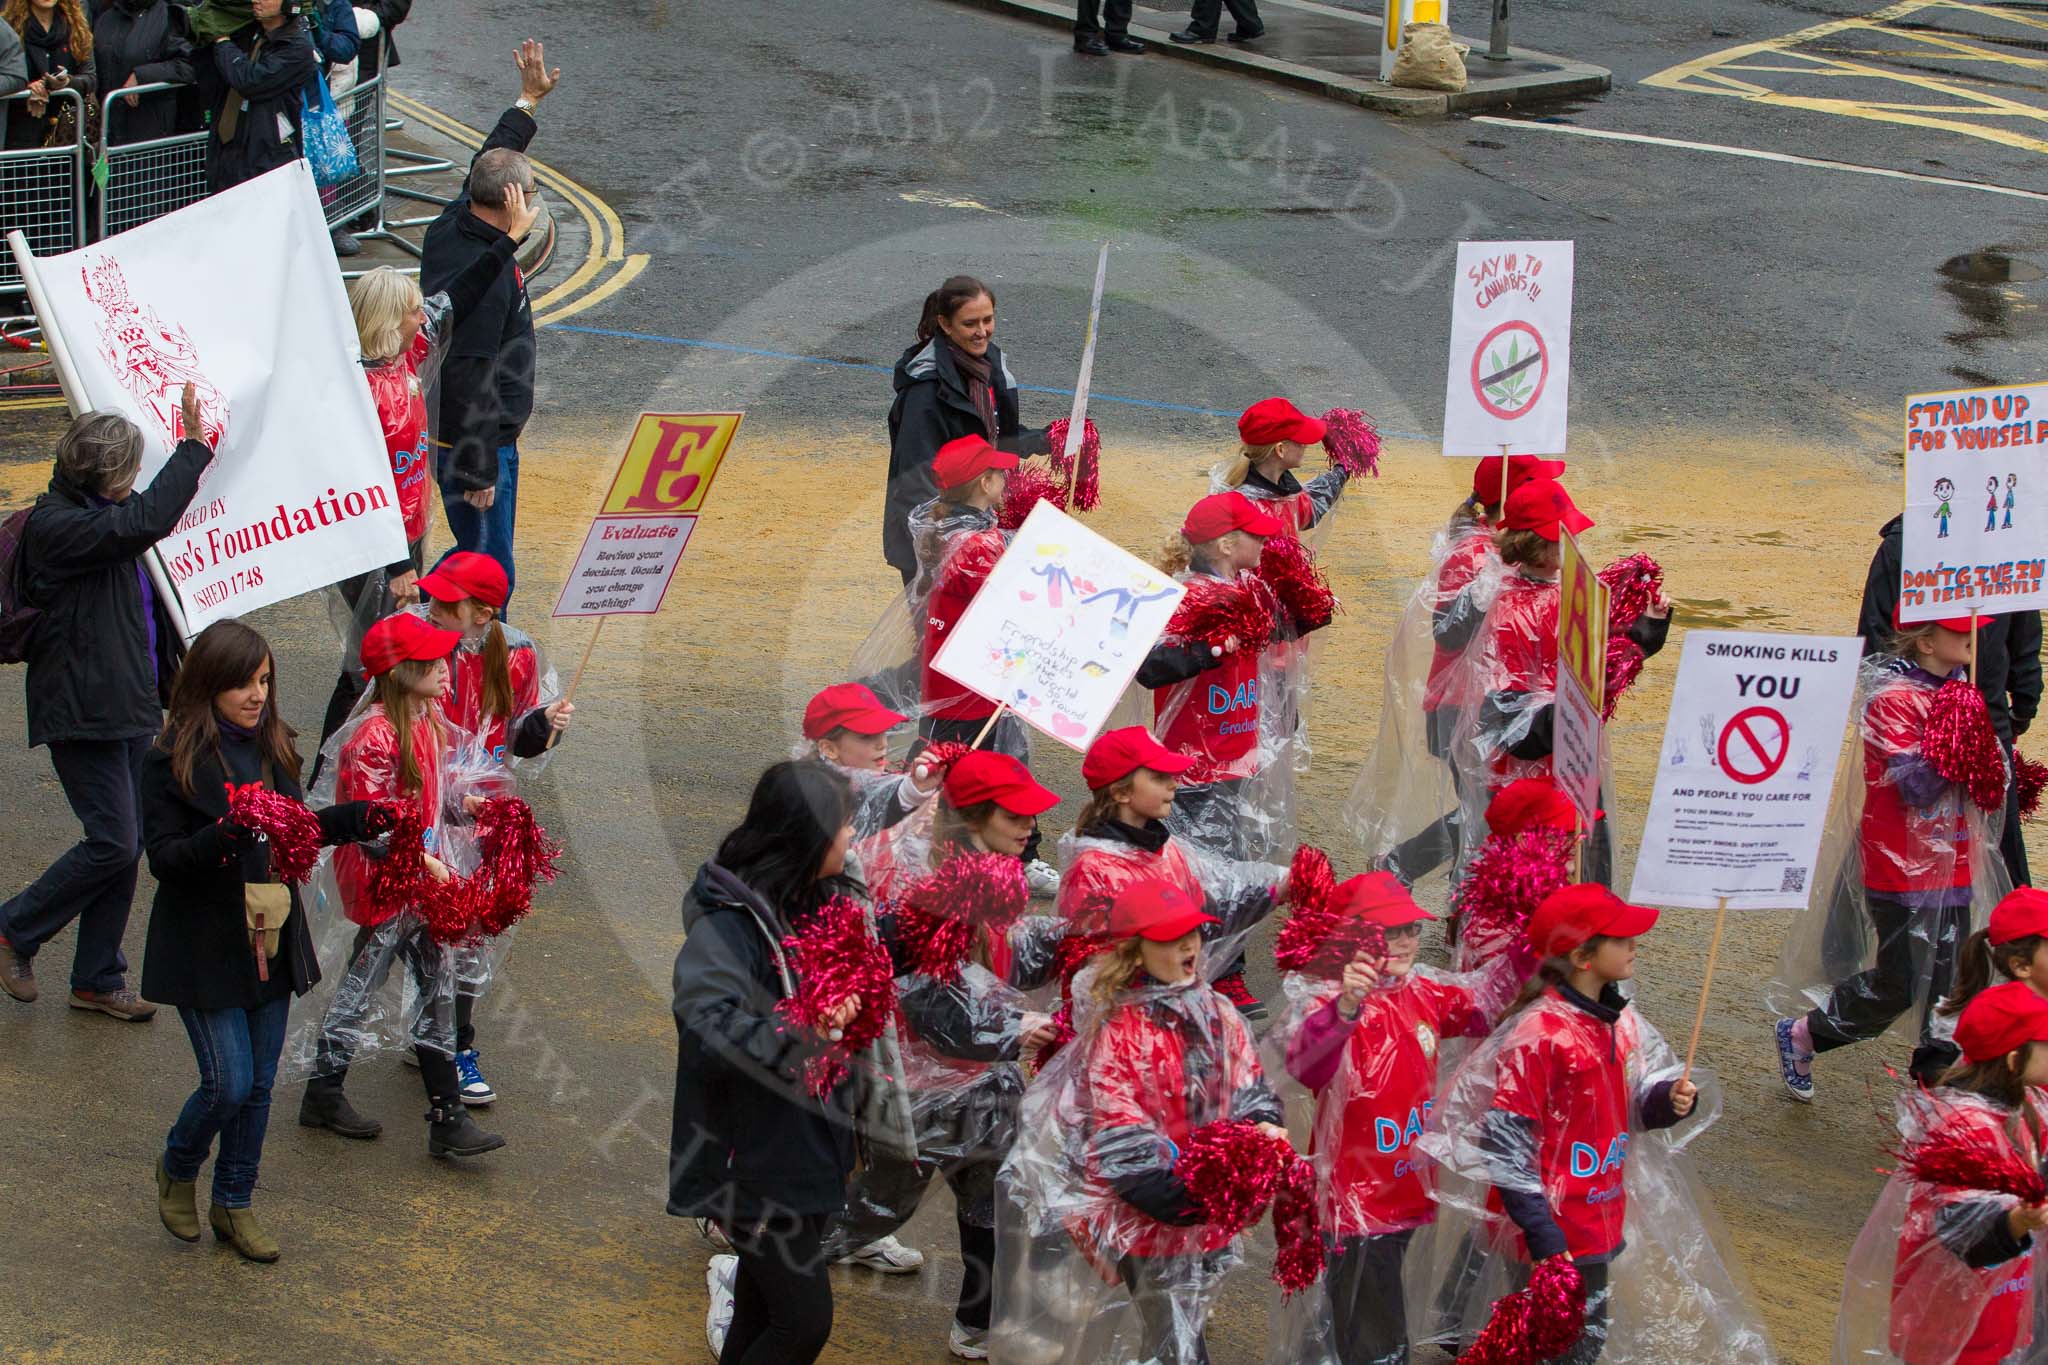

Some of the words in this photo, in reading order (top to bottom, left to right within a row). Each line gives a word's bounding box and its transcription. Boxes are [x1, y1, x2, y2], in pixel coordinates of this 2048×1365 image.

[1468, 255, 1501, 287] SAY
[1526, 254, 1543, 276] TO
[1908, 396, 1988, 428] STAND
[1992, 394, 2030, 421] UP
[1908, 429, 1947, 452] FOR
[1951, 420, 2048, 450] YOURSELF
[624, 420, 718, 510] E
[210, 496, 226, 521] BY
[206, 484, 390, 567] Foundation
[601, 524, 679, 541] Evaluate
[596, 550, 635, 561] Review
[637, 551, 663, 561] your
[231, 565, 264, 595] 1748
[582, 566, 627, 577] decision.
[631, 565, 664, 576] Would
[1903, 561, 1957, 589] DON'T
[1956, 562, 2014, 587] GIVE
[2015, 559, 2046, 580] IN
[585, 584, 606, 594] you
[608, 582, 644, 593] change
[1902, 590, 1925, 607] TO
[1932, 585, 1975, 602] PEER
[581, 597, 636, 610] anything?
[1706, 643, 1785, 660] SMOKING
[1791, 648, 1838, 663] KILLS
[1735, 673, 1801, 699] YOU
[1672, 788, 1694, 797] AND
[1697, 789, 1739, 800] PEOPLE
[1741, 793, 1763, 802] YOU
[1766, 793, 1790, 802] CARE
[1793, 793, 1812, 802] FOR
